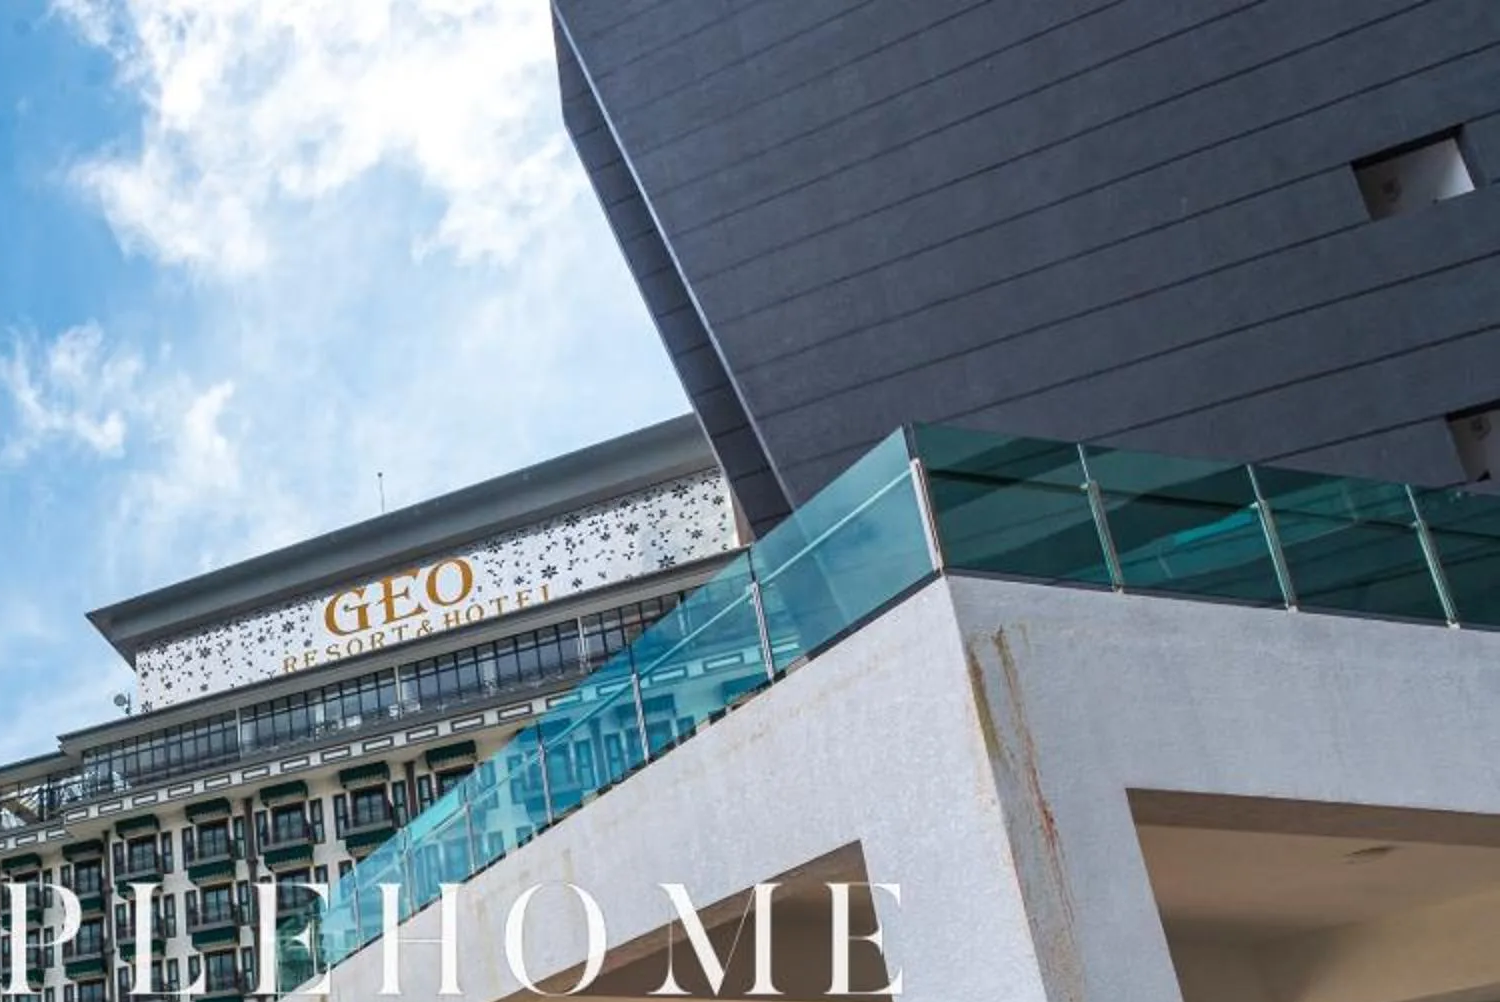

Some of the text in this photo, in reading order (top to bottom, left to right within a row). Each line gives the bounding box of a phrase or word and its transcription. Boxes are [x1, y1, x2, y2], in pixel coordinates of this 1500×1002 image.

[324, 557, 474, 636] GEO
[282, 621, 409, 675] RESORT
[415, 618, 434, 638] &
